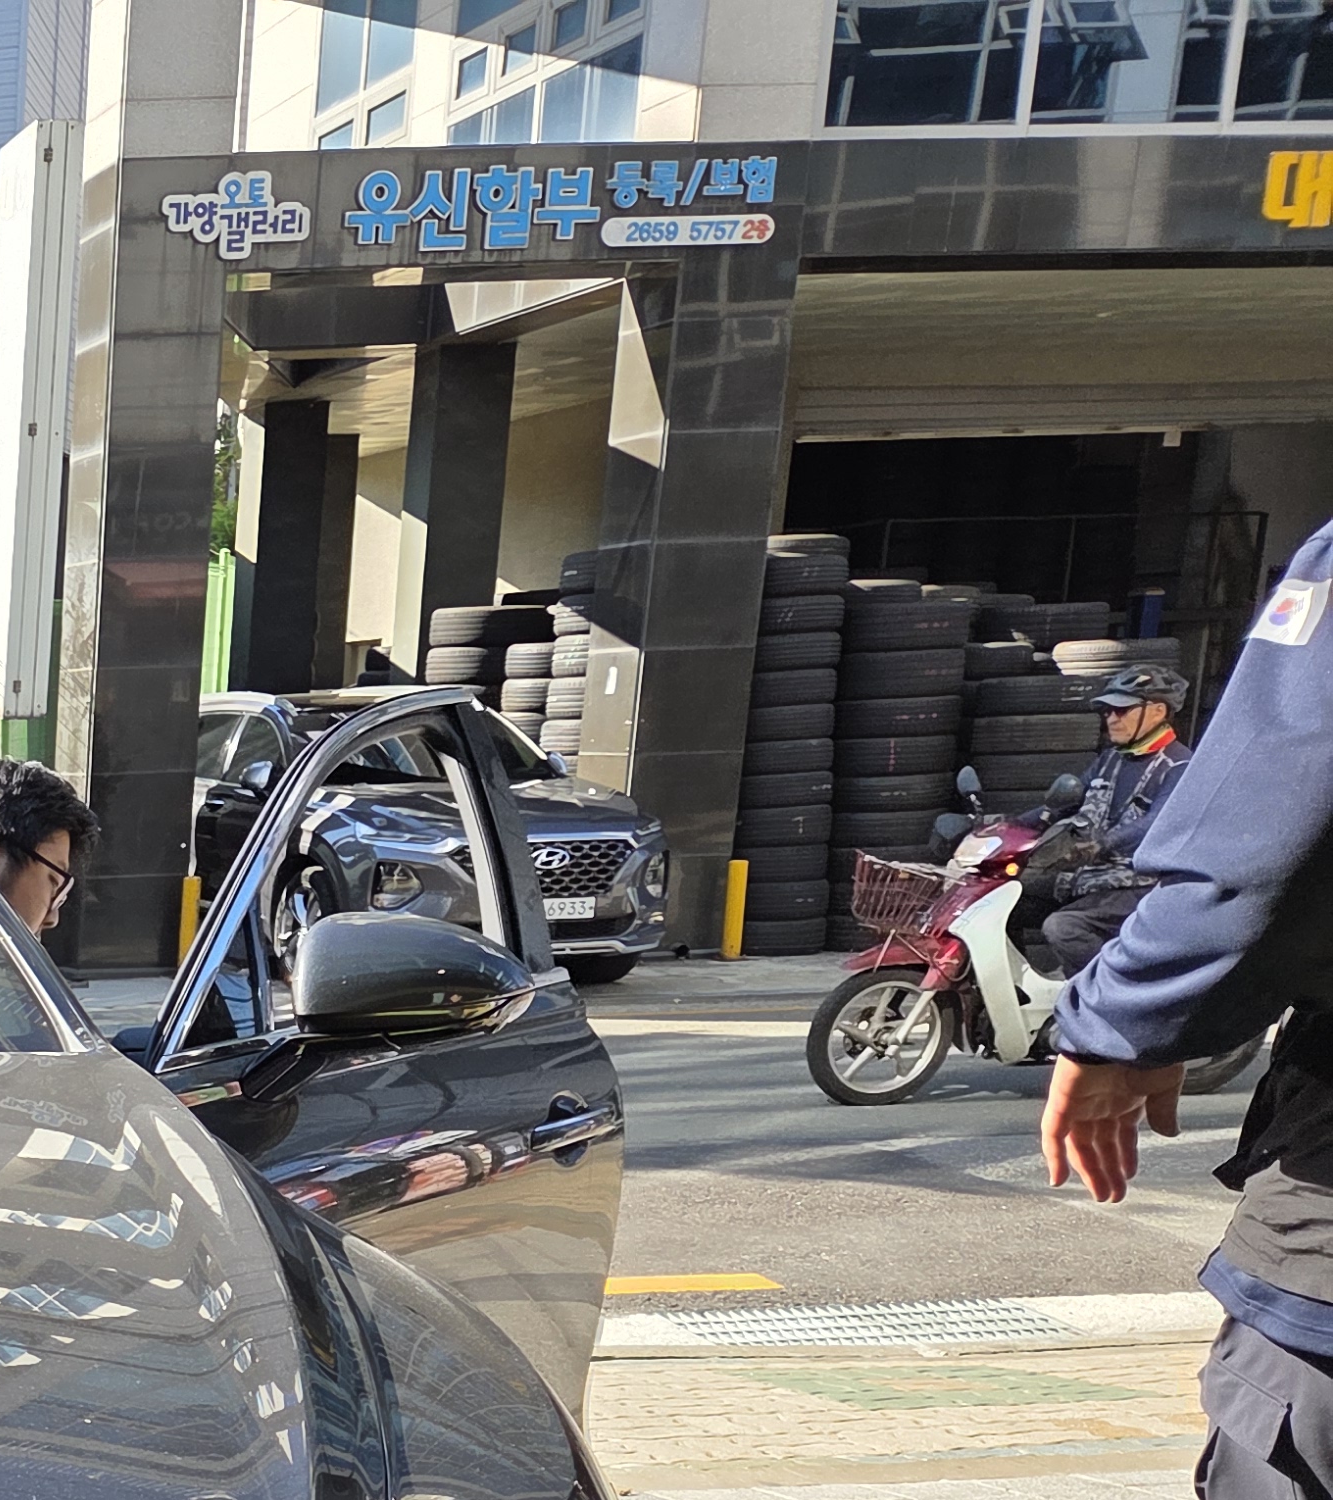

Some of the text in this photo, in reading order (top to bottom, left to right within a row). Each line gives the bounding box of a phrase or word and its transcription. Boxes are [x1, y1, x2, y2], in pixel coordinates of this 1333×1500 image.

[220, 177, 268, 210] 오토
[605, 155, 778, 209] 등록/보험
[168, 200, 219, 236] 가양
[344, 164, 601, 252] 유신할부
[219, 208, 304, 253] 갤러리
[625, 220, 679, 242] 2659
[689, 219, 740, 241] 5757
[547, 900, 587, 917] 6933
